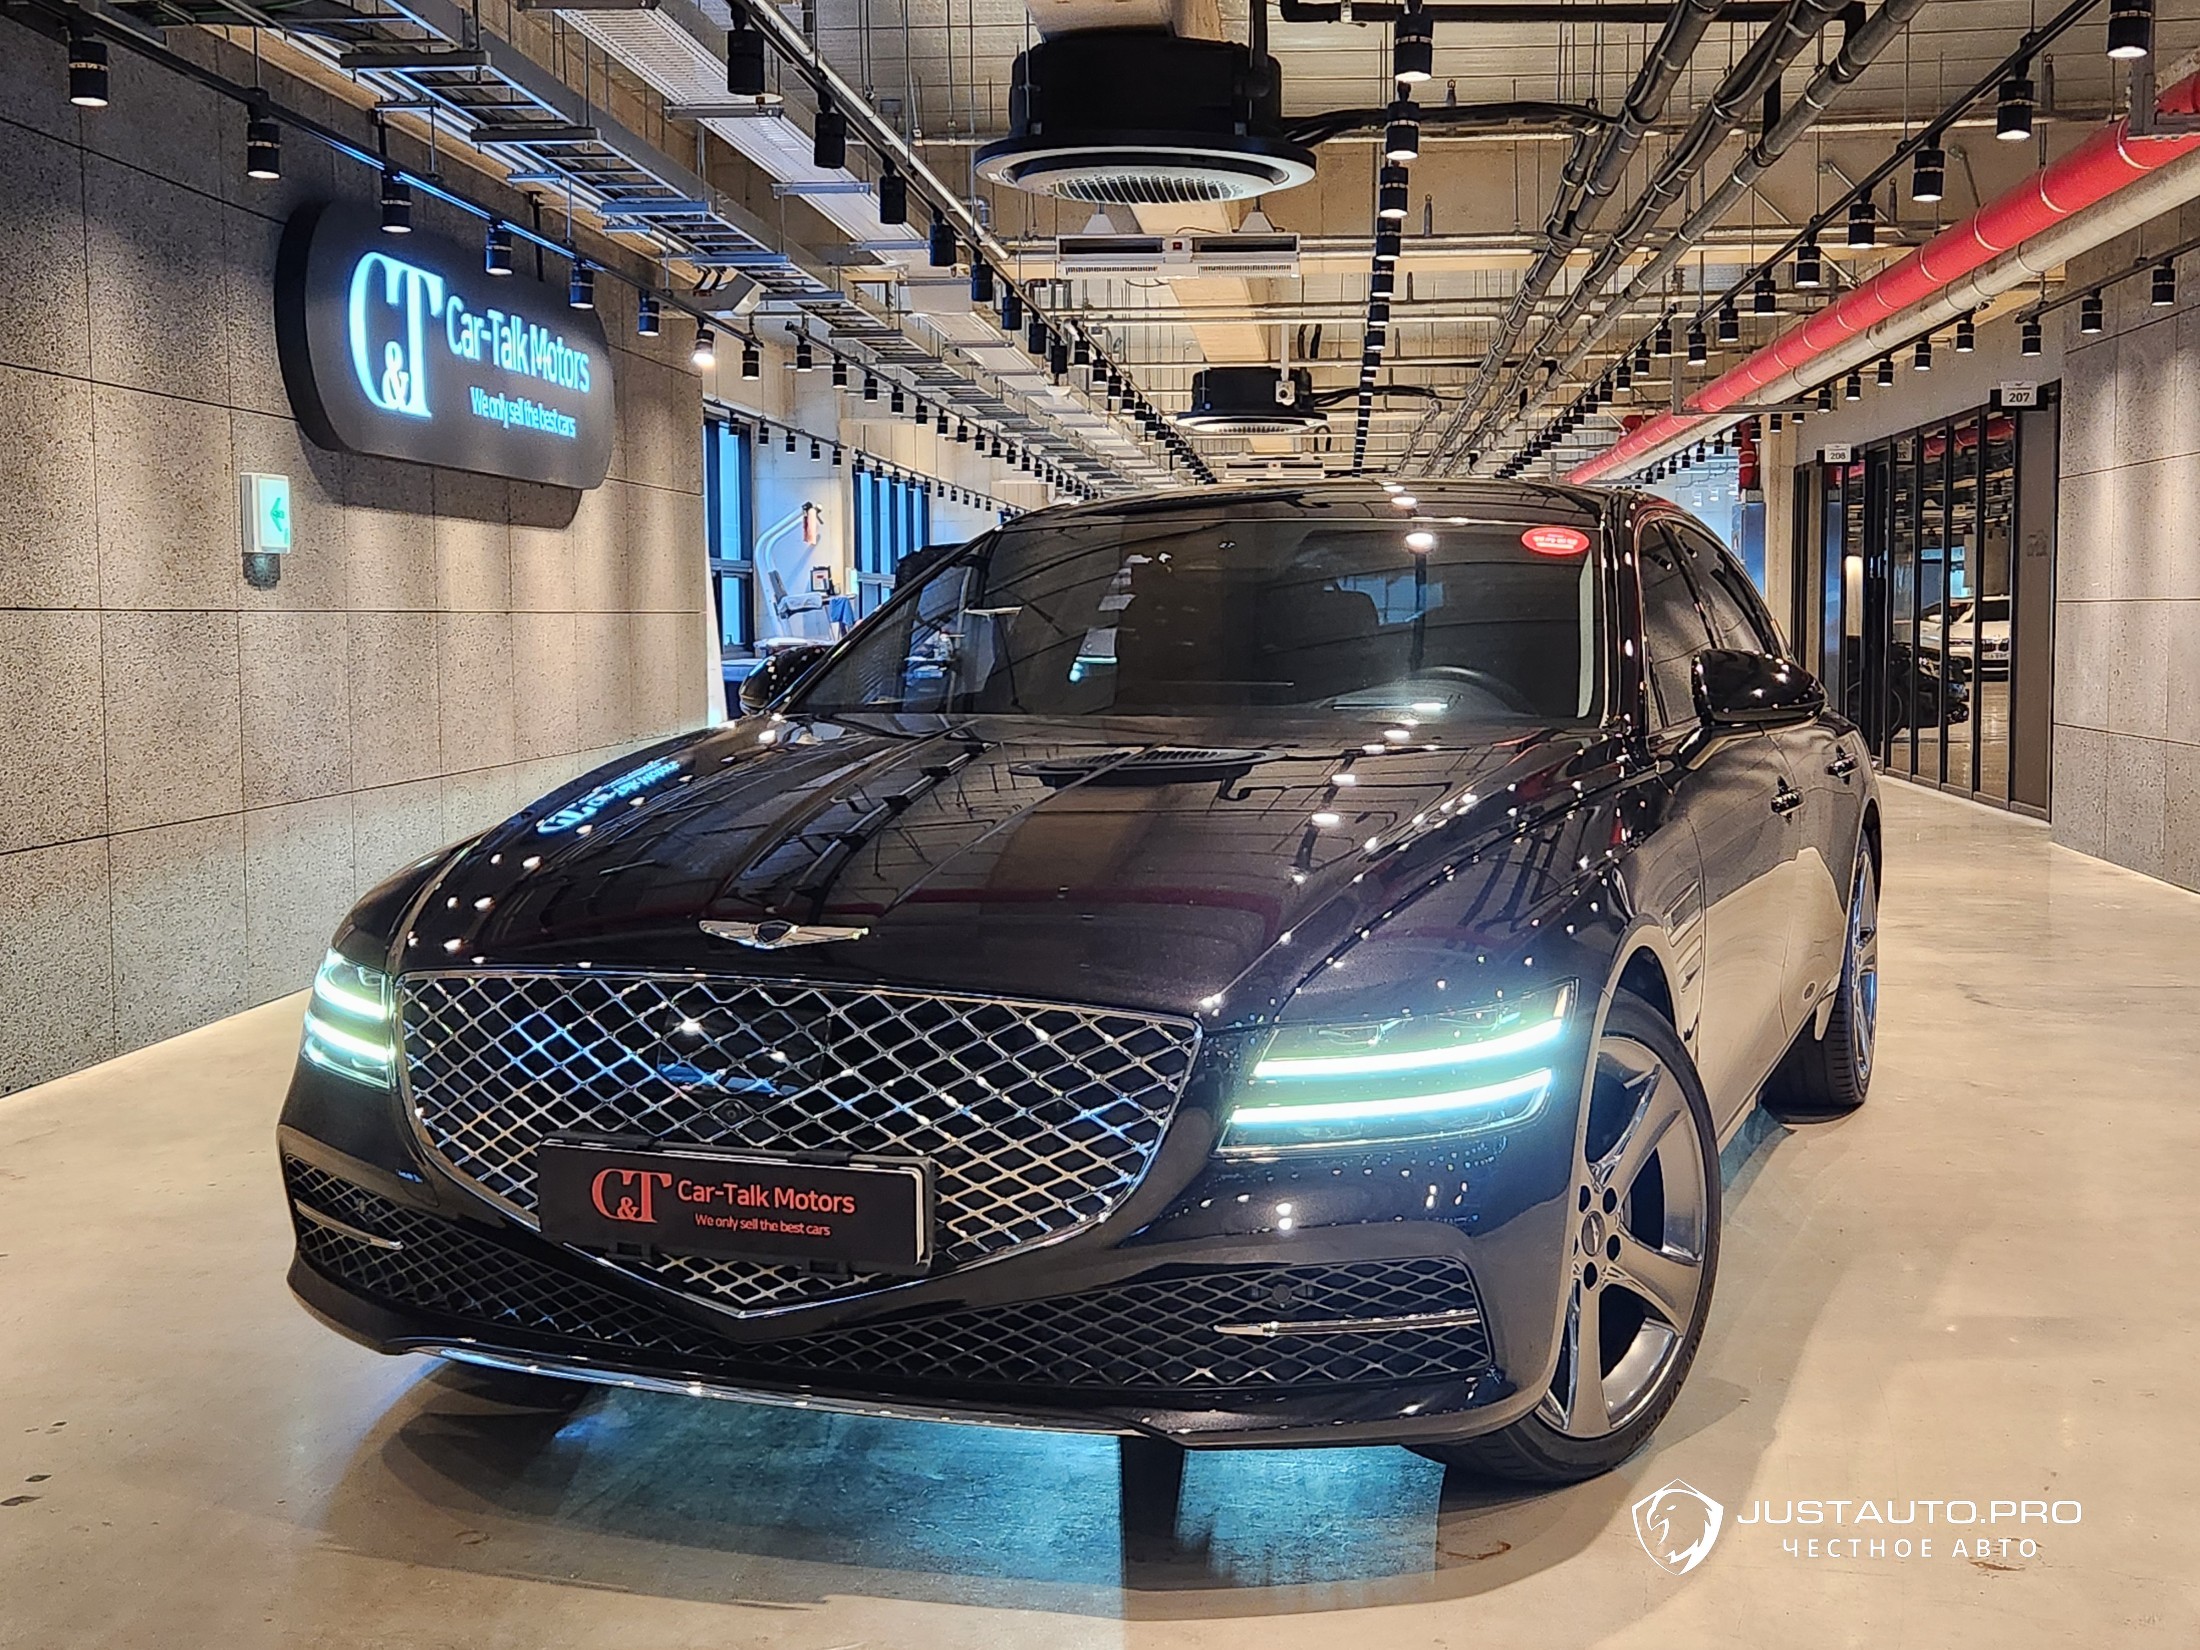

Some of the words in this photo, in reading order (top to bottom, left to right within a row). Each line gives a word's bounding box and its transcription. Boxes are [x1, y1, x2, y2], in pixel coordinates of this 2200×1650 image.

[446, 295, 529, 375] Car-Talk
[530, 324, 591, 393] Motors
[470, 386, 488, 418] We
[489, 392, 509, 429] only
[509, 397, 524, 425] sell
[524, 399, 539, 429] the
[538, 402, 558, 433] best
[558, 414, 576, 438] cars
[2009, 392, 2030, 403] 207
[678, 1180, 770, 1208] Car-Talk
[774, 1187, 856, 1214] Motors
[695, 1213, 714, 1226] We
[715, 1215, 738, 1231] only
[740, 1218, 758, 1231] sell
[760, 1219, 778, 1232] the
[780, 1220, 805, 1235] best
[806, 1225, 831, 1236] cars
